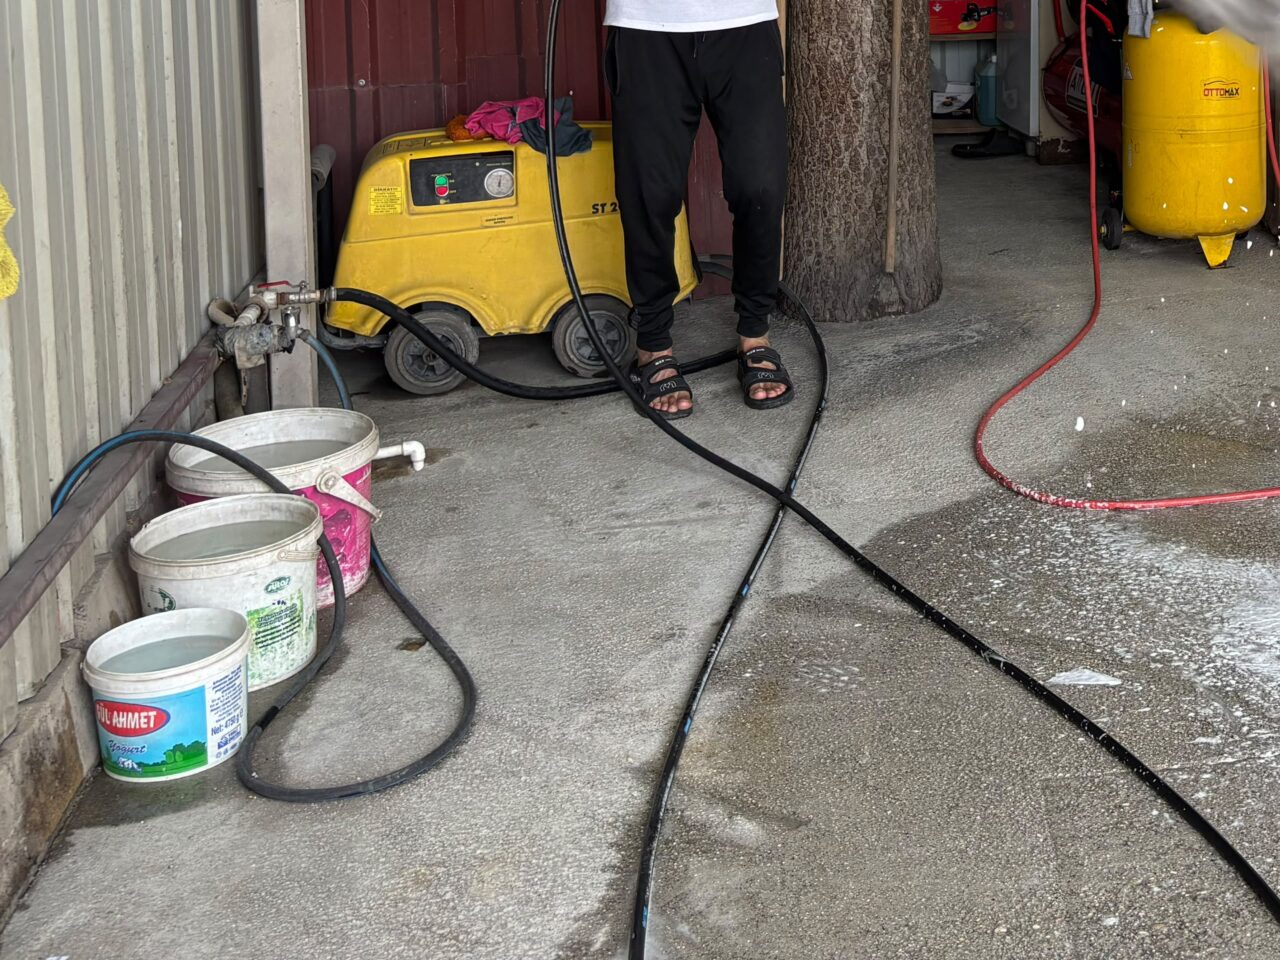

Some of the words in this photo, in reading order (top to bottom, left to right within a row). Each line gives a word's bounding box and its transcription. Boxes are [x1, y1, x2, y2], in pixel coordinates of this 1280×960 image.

[1203, 86, 1240, 97] OTTOMAX
[591, 202, 607, 215] ST
[112, 711, 157, 729] AHMET
